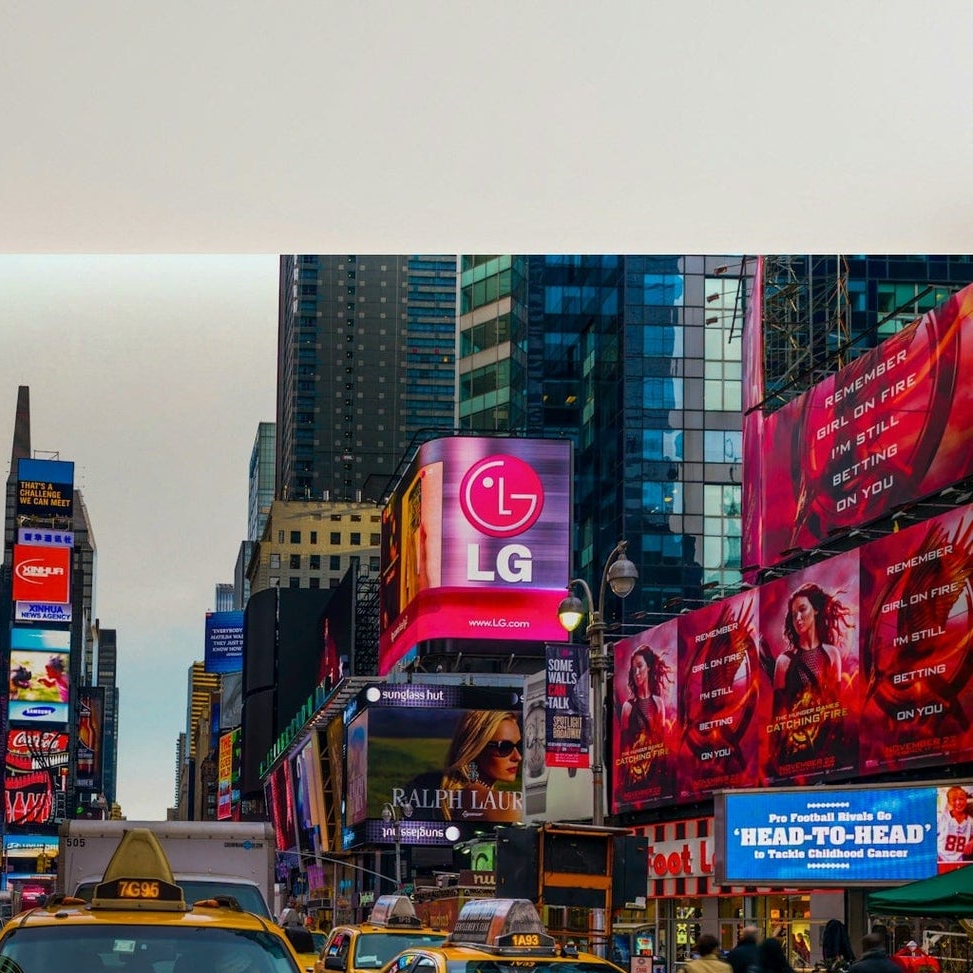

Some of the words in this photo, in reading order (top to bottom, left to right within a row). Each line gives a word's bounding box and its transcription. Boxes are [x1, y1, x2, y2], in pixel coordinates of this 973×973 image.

[824, 349, 907, 408] REMEMBER
[816, 418, 849, 441] GIRL
[853, 400, 875, 420] ON
[880, 372, 917, 403] FIRE
[831, 440, 851, 459] I'M
[856, 415, 900, 445] STILL
[832, 443, 898, 487] BETTING
[20, 481, 45, 490] THAT'S
[19, 489, 61, 499] CHALLENGE
[836, 494, 857, 512] ON
[862, 475, 894, 499] YOU
[19, 497, 32, 505] WE
[34, 497, 49, 506] CAN
[50, 499, 71, 507] MEET
[466, 543, 533, 583] LG
[885, 545, 954, 576] REMEMBER
[881, 600, 908, 614] GIRL
[910, 592, 927, 605] ON
[931, 582, 959, 599] FIRE
[21, 611, 41, 619] NEWS
[42, 612, 71, 621] AGENCY
[28, 604, 64, 614] XINHUA
[468, 618, 531, 629] www.LG.com
[694, 621, 739, 644] REMEMBER
[893, 634, 909, 647] I'M
[911, 626, 946, 642] STILL
[548, 659, 573, 672] SOME
[692, 663, 710, 674] GIRL
[711, 659, 724, 670] ON
[725, 652, 742, 666] FIRE
[548, 671, 577, 684] WALLS
[893, 664, 947, 684] BETTING
[382, 690, 425, 705] sunglass
[427, 689, 444, 701] hut
[548, 684, 567, 696] CAN
[711, 686, 733, 699] STILL
[548, 697, 569, 709] TALK
[896, 709, 915, 721] ON
[917, 704, 943, 717] YOU
[699, 716, 733, 731] BETTING
[766, 713, 820, 734] CATCHING
[823, 707, 848, 721] FIRE
[616, 753, 652, 766] CATCHING
[701, 751, 713, 761] ON
[714, 748, 731, 759] YOU
[392, 787, 463, 808] RALPH
[471, 790, 523, 810] LAUR
[769, 814, 787, 823] Pro
[790, 812, 835, 823] Football
[838, 811, 873, 823] Rivals
[877, 811, 892, 822] Go
[66, 838, 86, 847] 505
[944, 834, 966, 853] 88
[754, 850, 765, 859] to
[768, 849, 805, 859] Tackle
[808, 848, 864, 859] Childhood
[867, 848, 908, 858] Cancer
[511, 934, 539, 946] 1A93
